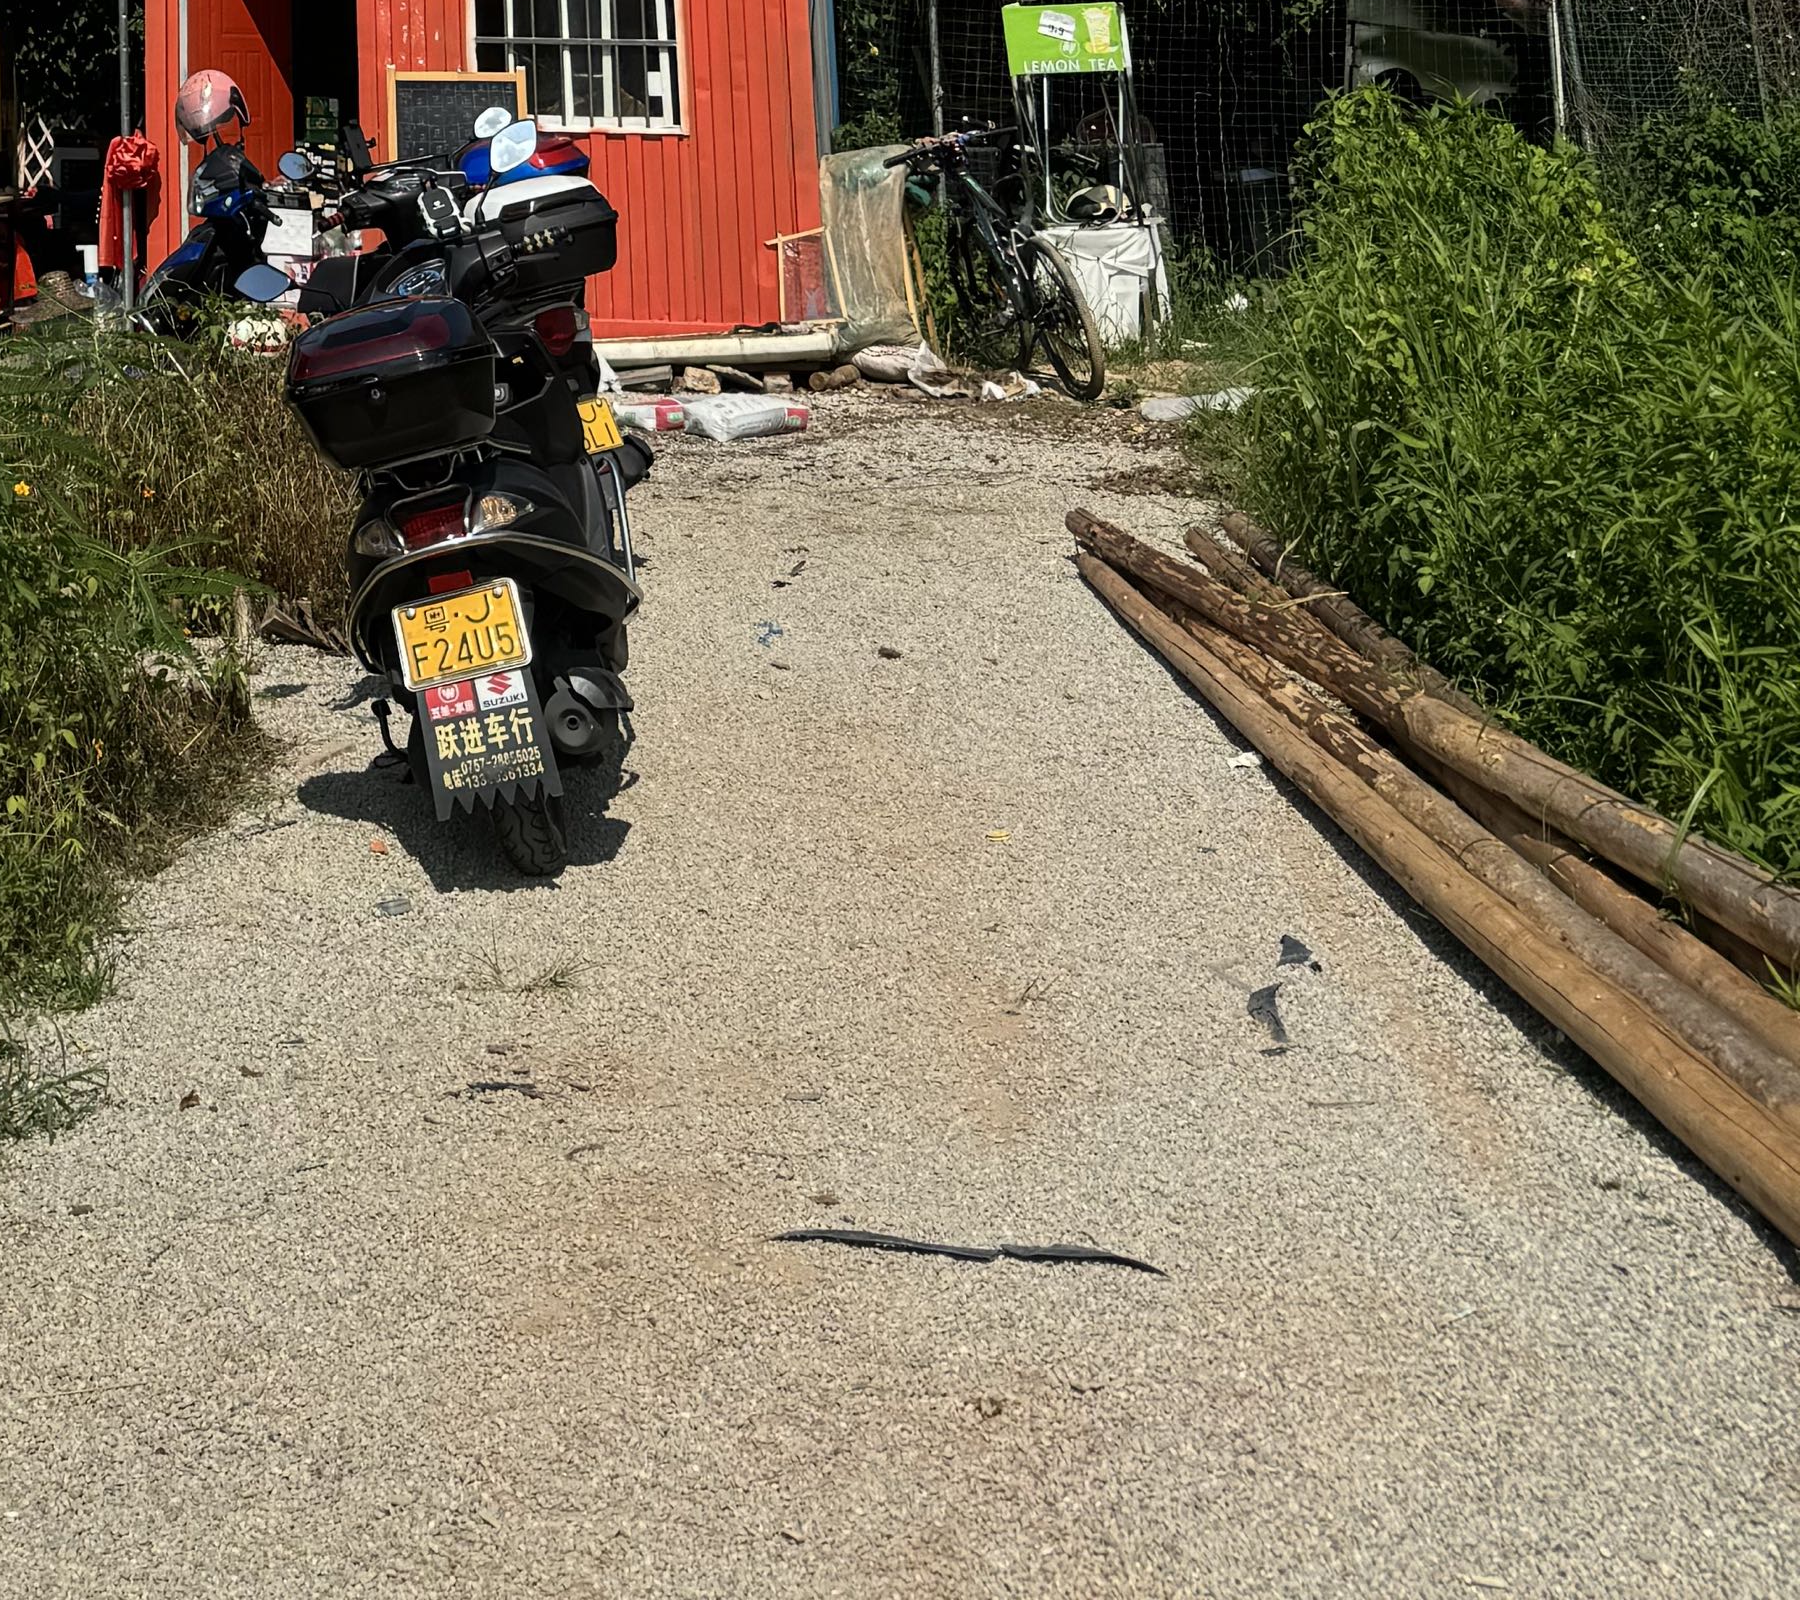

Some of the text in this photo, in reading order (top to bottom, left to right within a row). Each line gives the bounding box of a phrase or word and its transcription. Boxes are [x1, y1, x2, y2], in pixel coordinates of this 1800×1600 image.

[1023, 58, 1118, 74] LEMON TEA
[412, 622, 515, 677] F24U5
[483, 692, 525, 708] SUZUKI
[434, 707, 533, 761] 跃进车行
